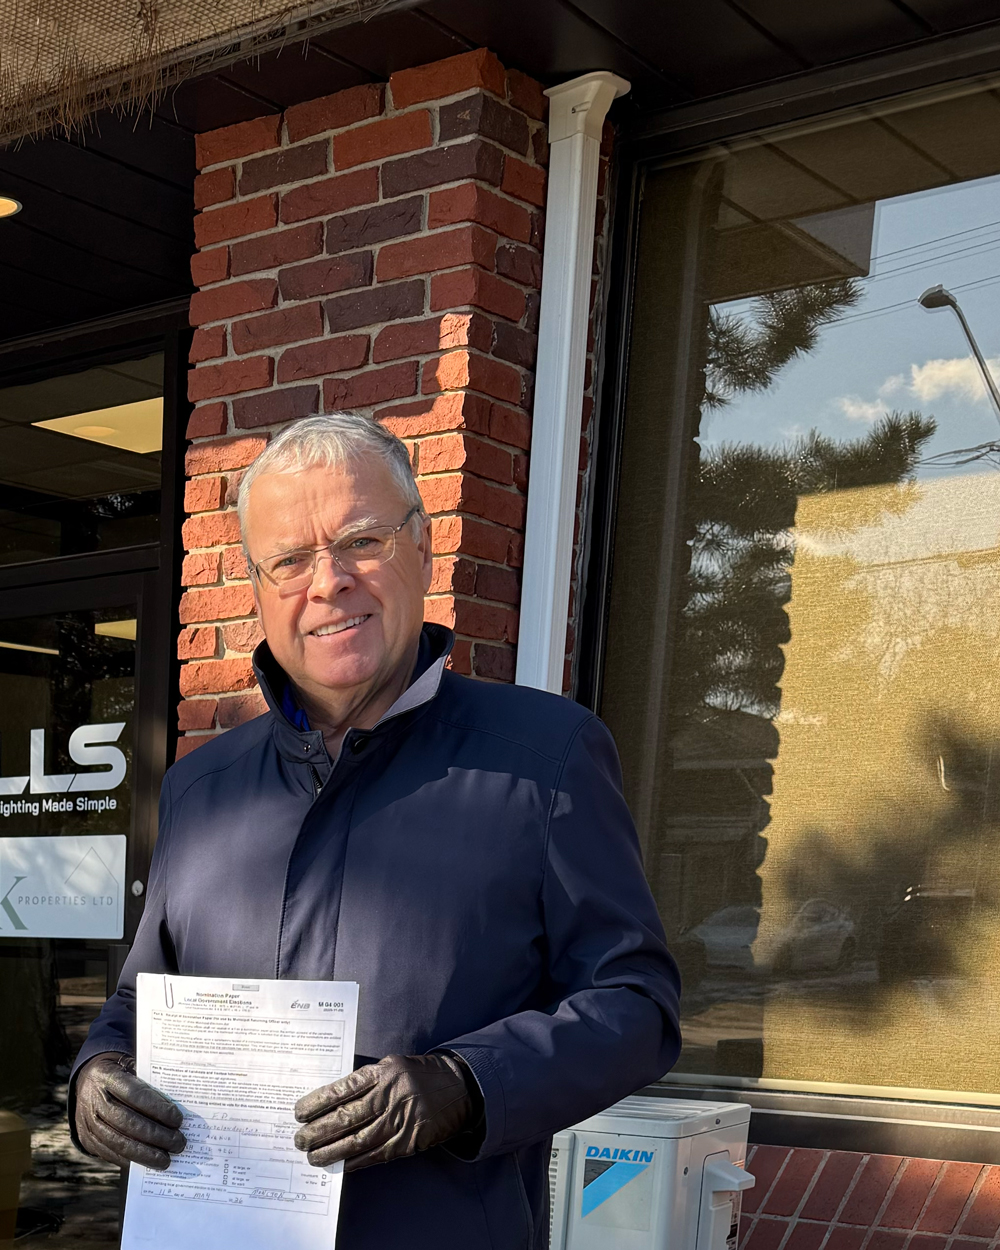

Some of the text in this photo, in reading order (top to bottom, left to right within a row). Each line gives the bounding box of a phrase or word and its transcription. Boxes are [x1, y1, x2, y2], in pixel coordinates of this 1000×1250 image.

[42, 798, 74, 812] Made
[76, 796, 116, 813] Simple
[18, 896, 114, 906] PROPERTIES LTD
[586, 1146, 654, 1163] DAIKIN
